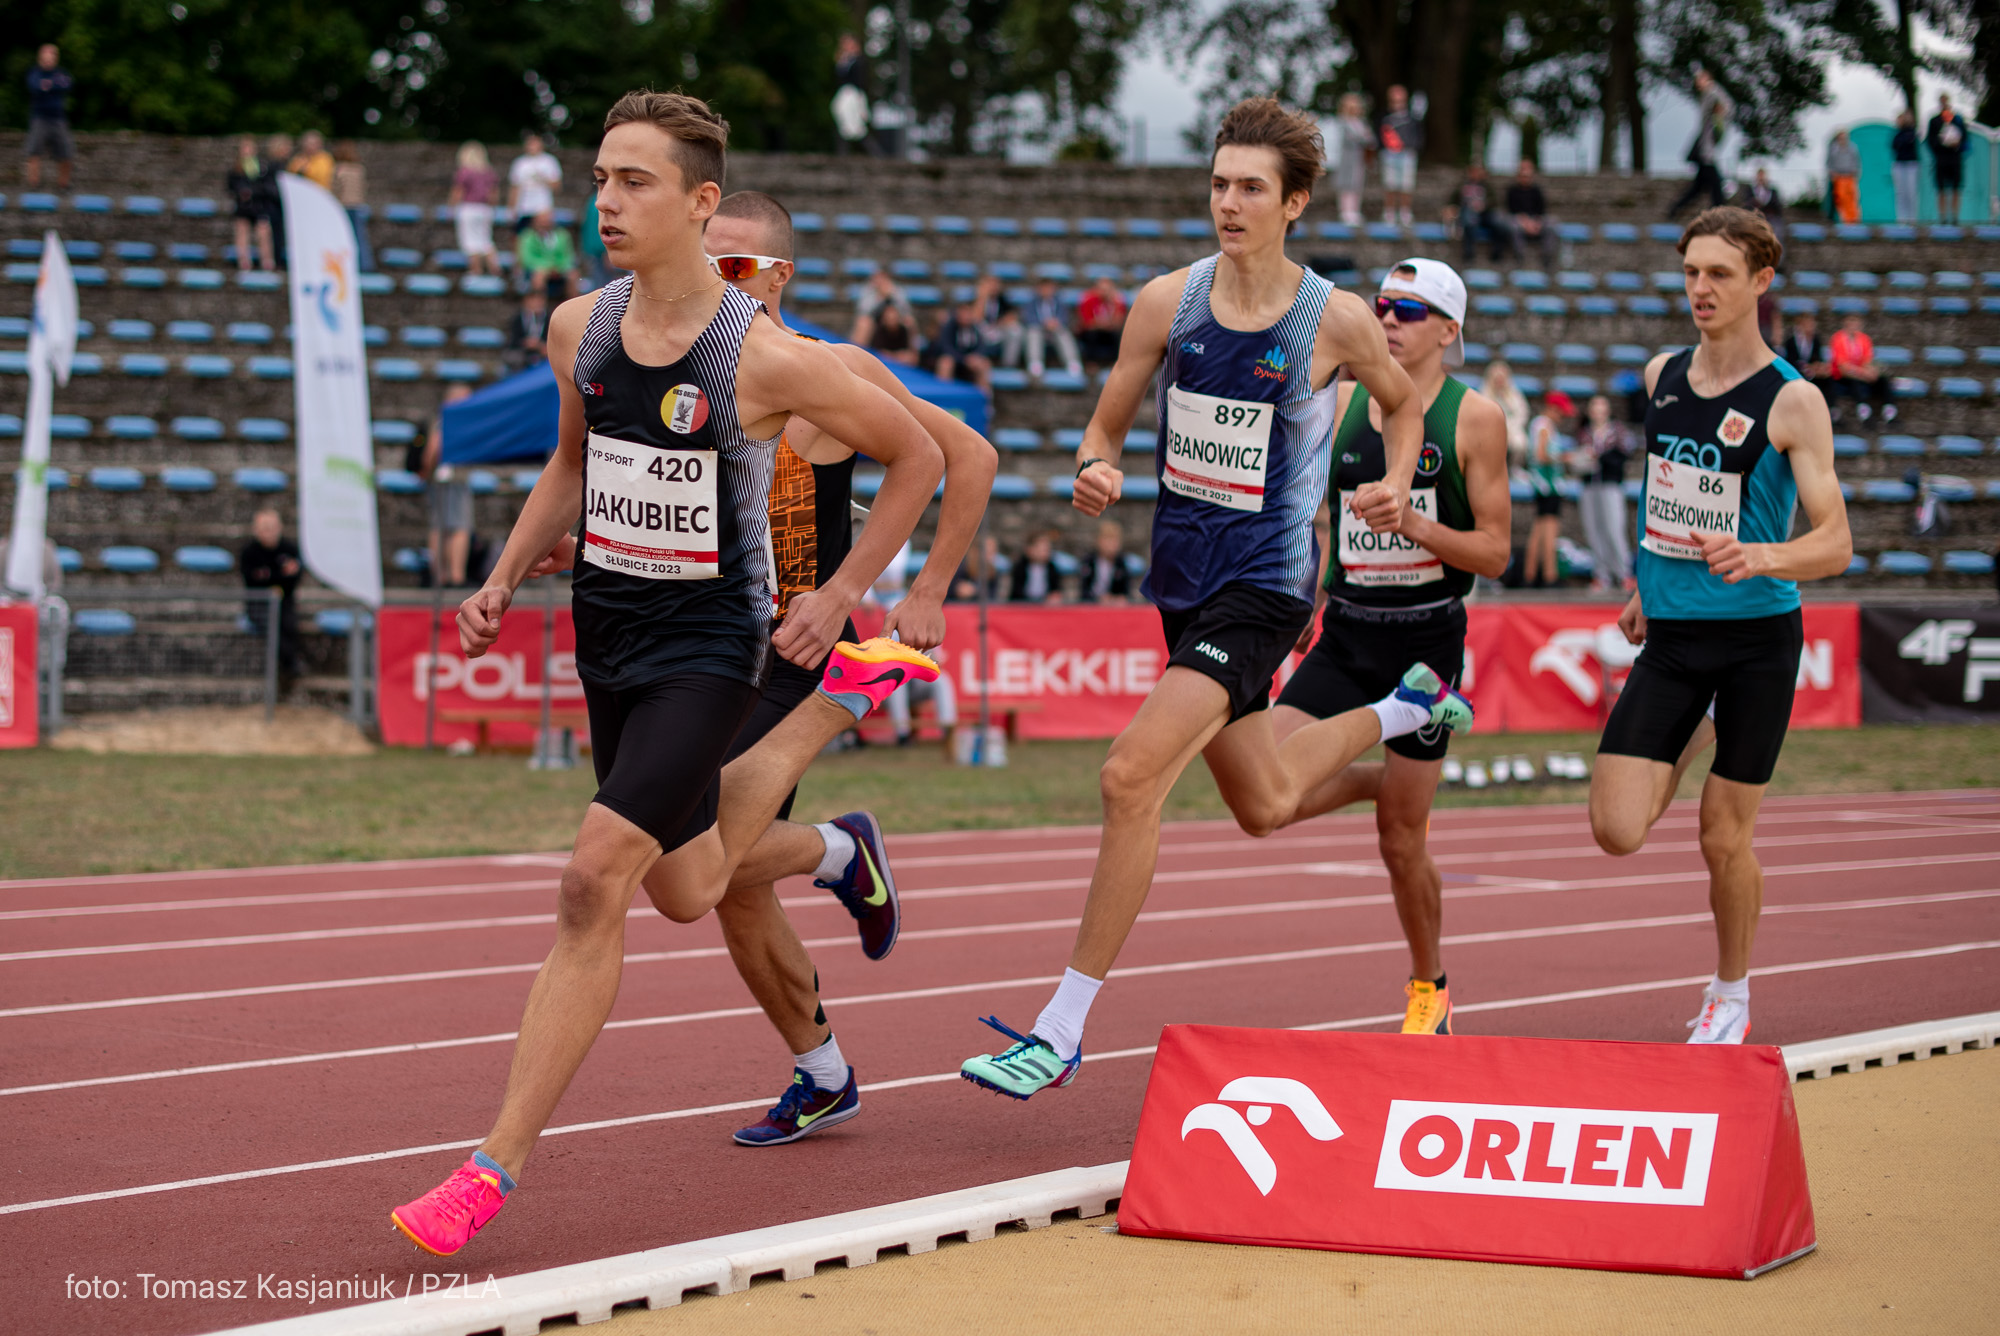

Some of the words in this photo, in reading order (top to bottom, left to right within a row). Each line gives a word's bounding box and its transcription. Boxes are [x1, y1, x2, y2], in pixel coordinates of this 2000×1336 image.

[1254, 366, 1287, 382] Dywity
[1215, 405, 1261, 428] 897
[588, 447, 603, 460] TVP
[604, 452, 635, 467] SPORT
[1167, 430, 1263, 471] RBANOWICZ
[647, 456, 702, 482] 420
[1171, 480, 1208, 496] SŁUBICE
[1209, 491, 1233, 503] 2023
[1699, 475, 1724, 495] 86
[588, 489, 710, 534] JAKUBIEC
[1649, 495, 1734, 532] GRZEŚKOWIAK
[1348, 531, 1421, 551] KOLAS
[605, 555, 649, 571] SŁUBICE
[650, 563, 681, 574] 2023
[1399, 573, 1420, 581] 2023
[1195, 642, 1229, 664] JAKO
[1898, 619, 1977, 665] 4F
[960, 650, 1165, 696] LEKKIE
[1399, 1115, 1692, 1190] ORLEN
